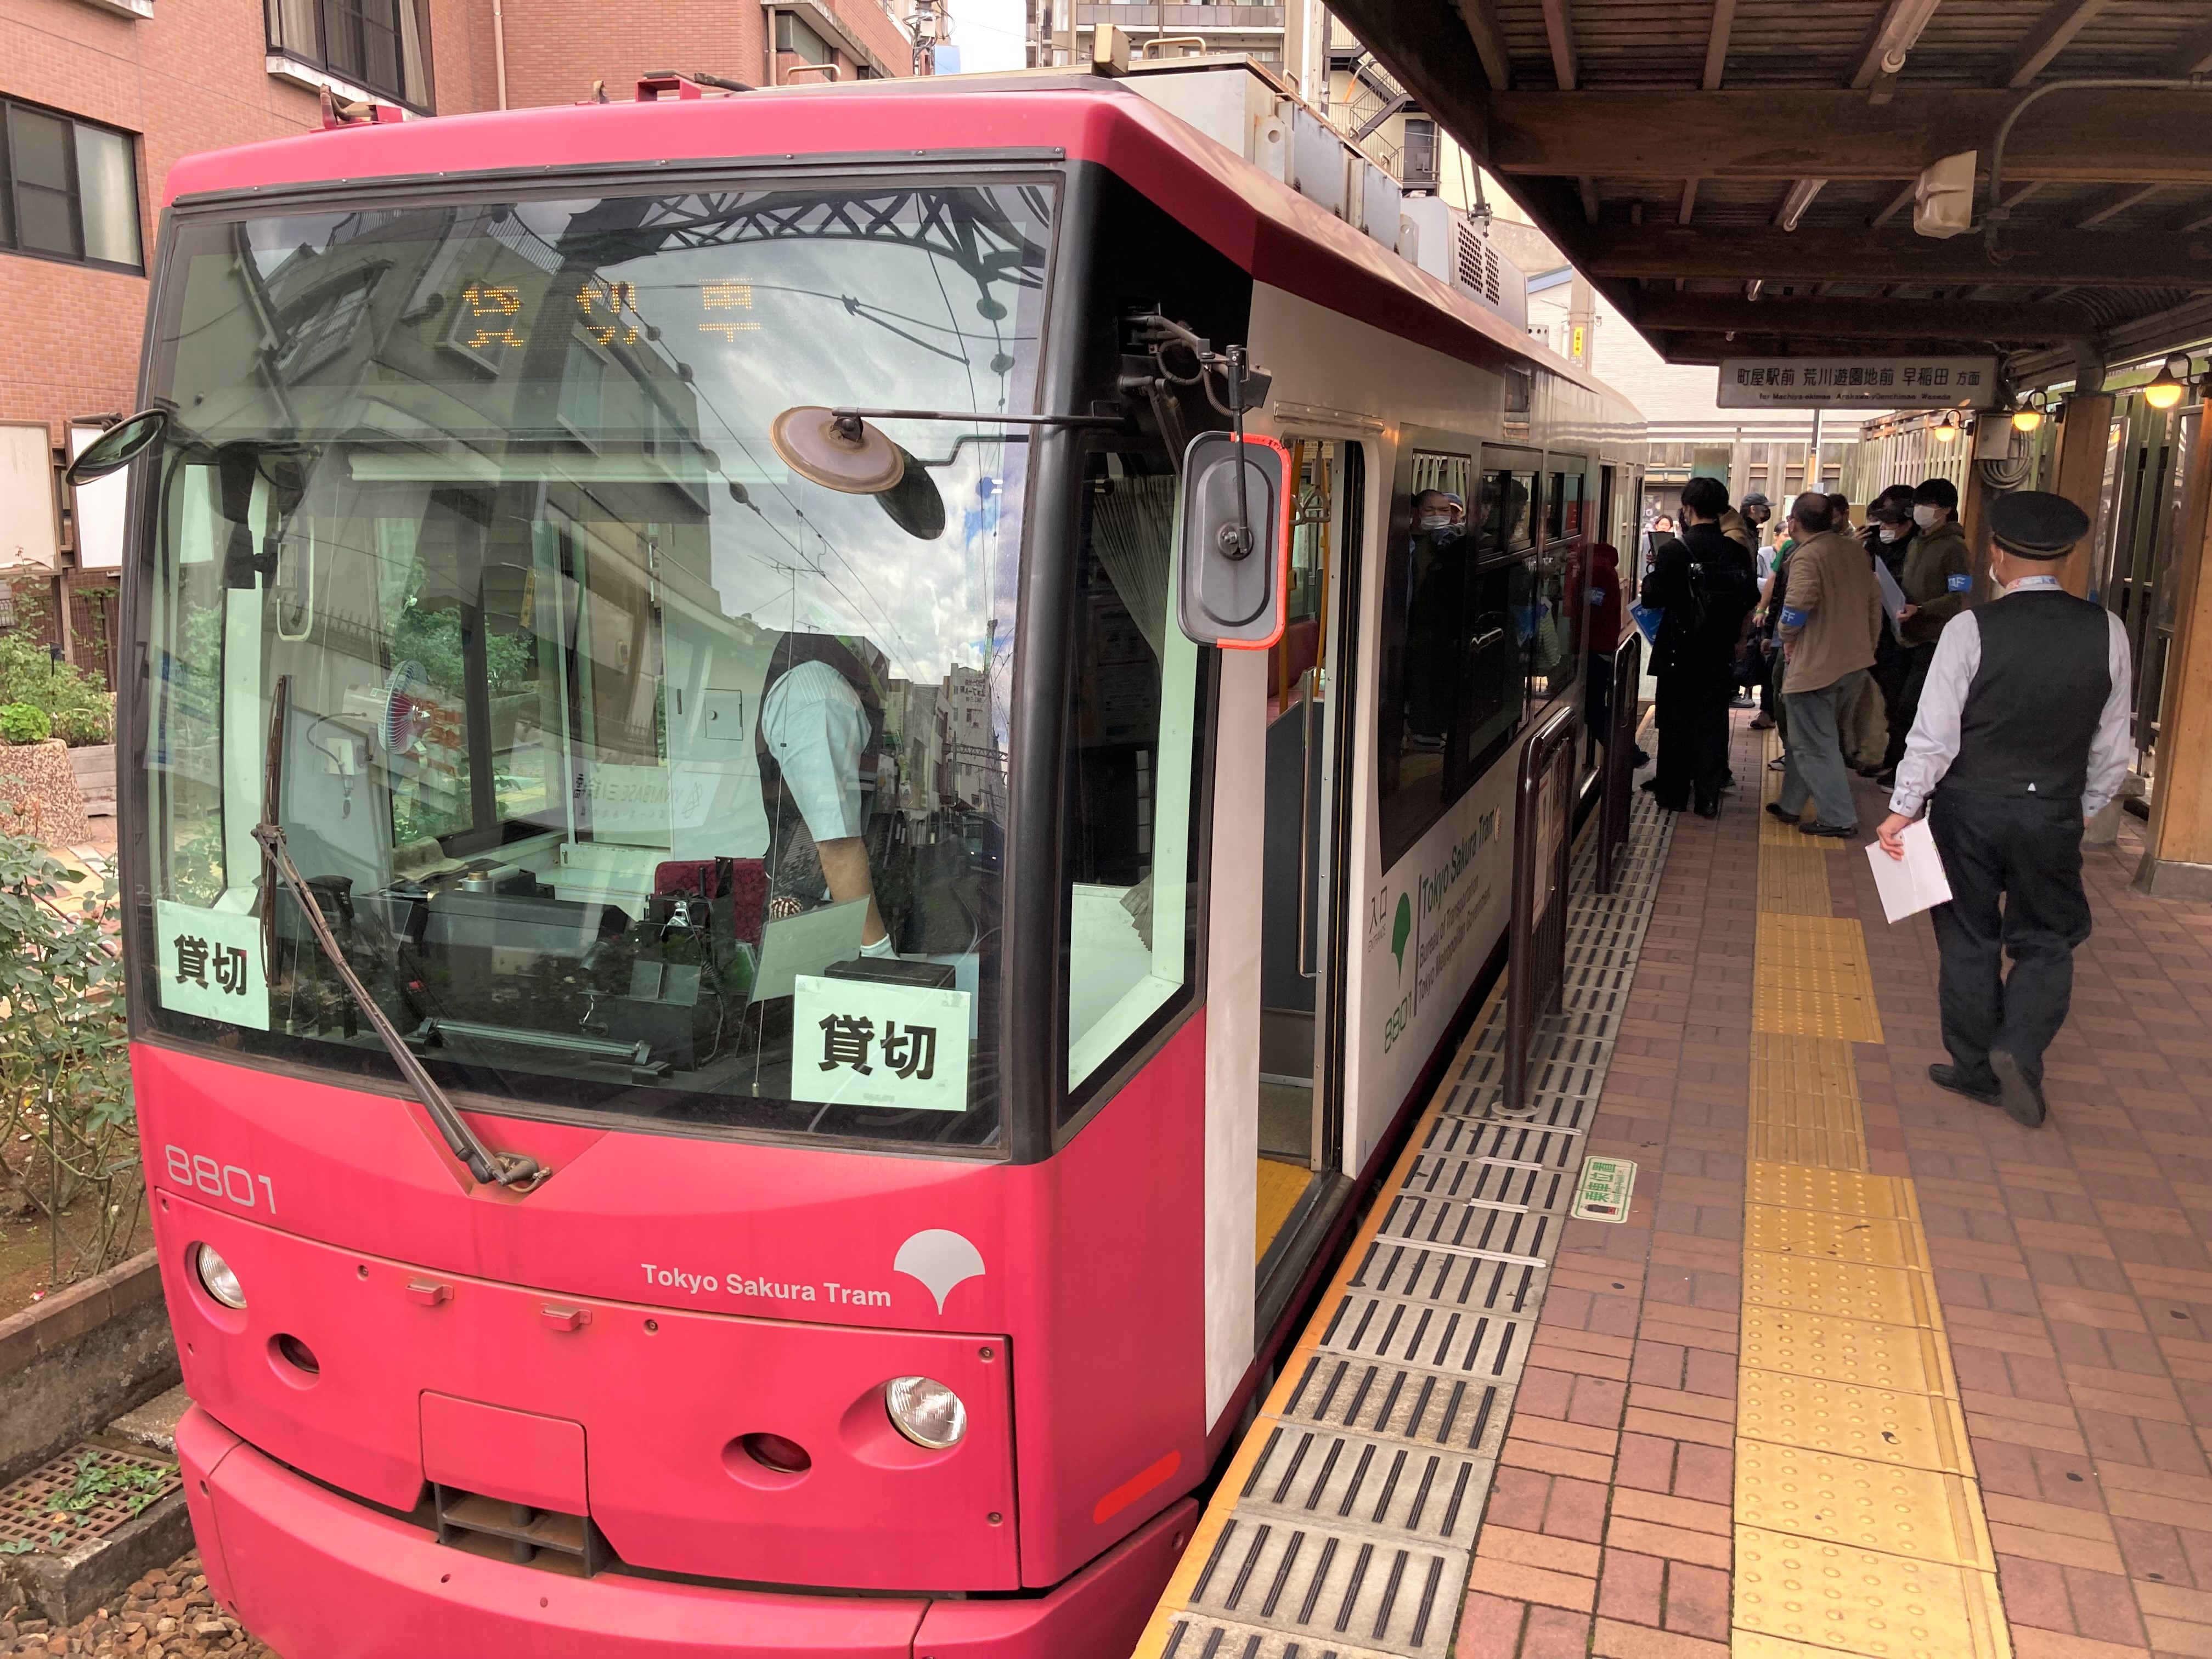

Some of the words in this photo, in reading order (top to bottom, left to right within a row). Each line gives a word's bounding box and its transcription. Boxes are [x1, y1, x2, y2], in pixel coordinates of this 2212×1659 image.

[1737, 367, 1795, 386] 町屋駅前
[1803, 367, 1894, 386] 荒川遊園地前
[1902, 367, 1949, 386] 早稲田
[1956, 370, 1980, 386] 方面
[1423, 864, 1449, 919] Tokyo
[1452, 828, 1477, 884] Sakura
[1369, 885, 1387, 934] 入口
[173, 934, 247, 996] 貸切
[818, 1013, 937, 1080] 貸切
[1385, 990, 1412, 1054] 8801
[165, 1145, 277, 1215] 8801
[641, 1263, 718, 1294] Tokyo
[726, 1273, 816, 1302] Sakura
[823, 1282, 891, 1308] Tram
